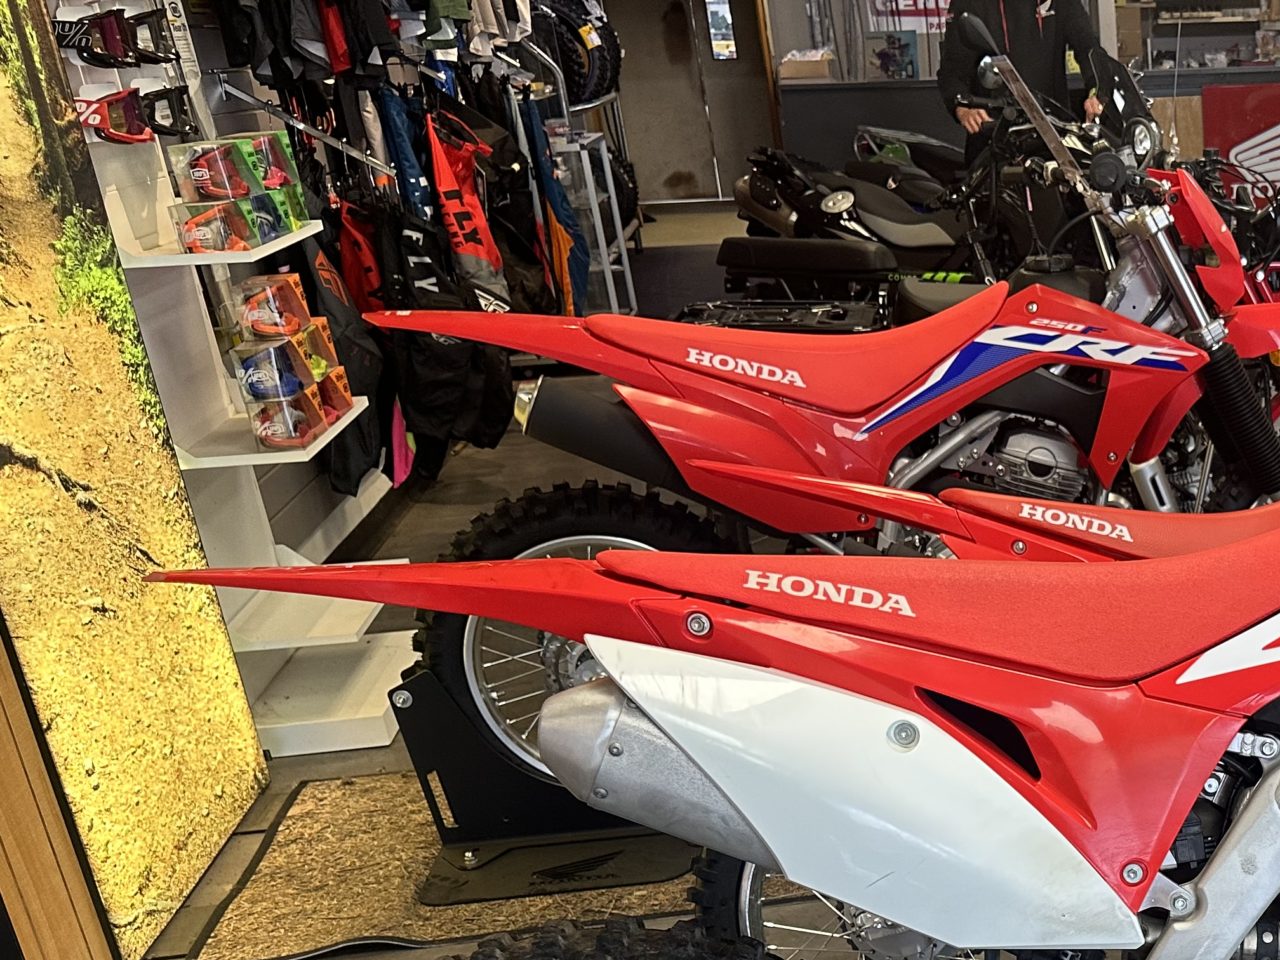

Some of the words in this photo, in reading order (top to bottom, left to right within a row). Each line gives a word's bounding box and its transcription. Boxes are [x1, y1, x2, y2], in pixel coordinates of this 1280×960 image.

[402, 229, 440, 294] FLY
[686, 347, 807, 388] HONDA
[1018, 502, 1134, 542] HONDA
[743, 569, 917, 618] HONDA
